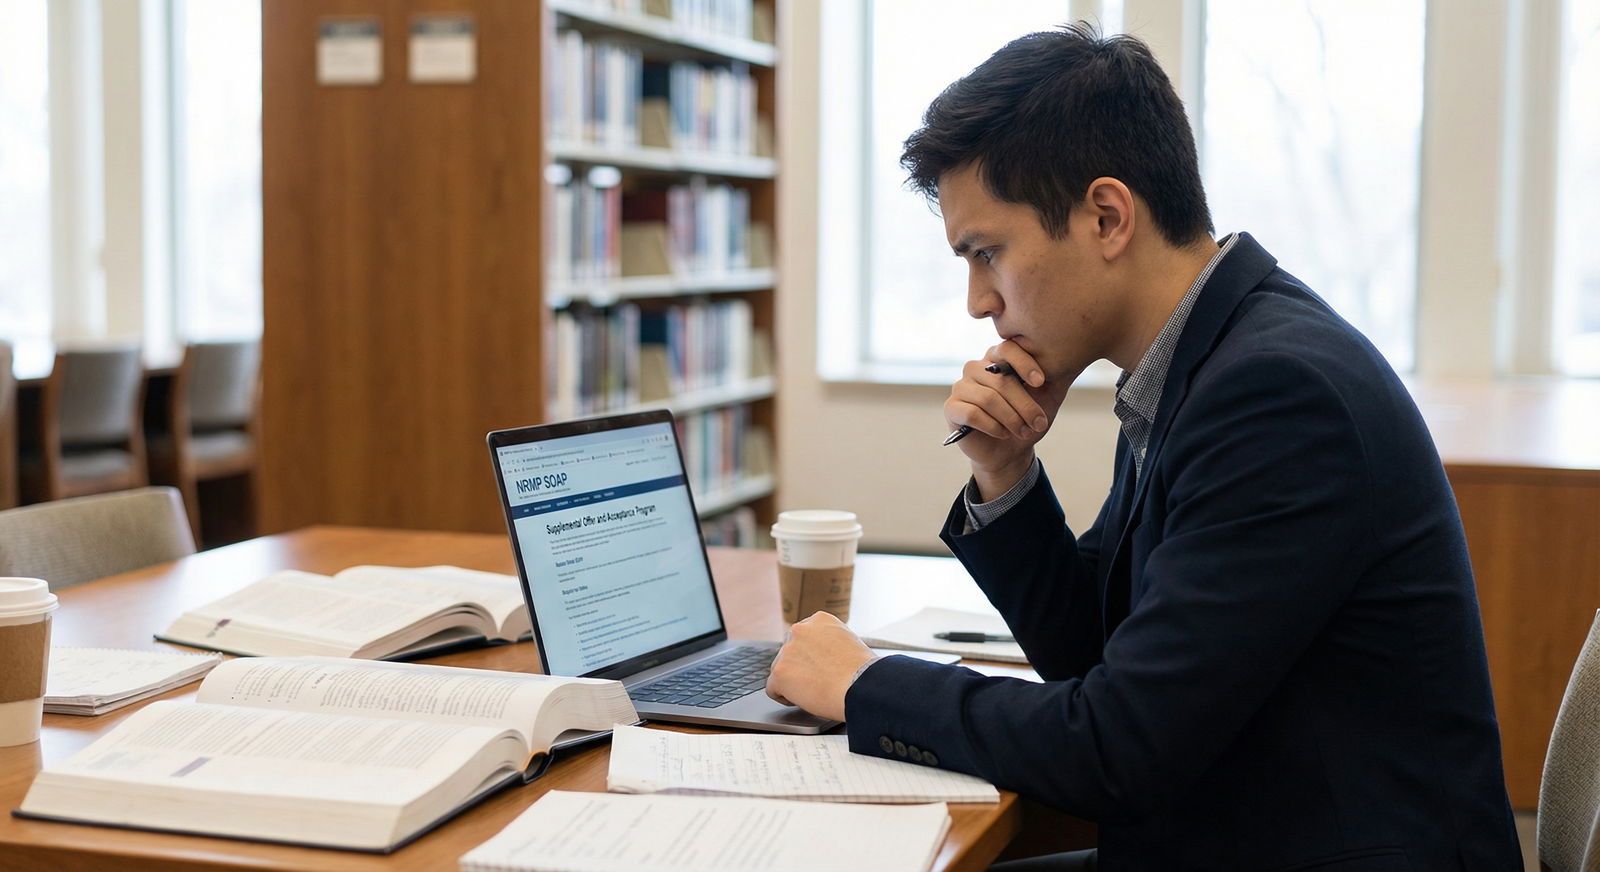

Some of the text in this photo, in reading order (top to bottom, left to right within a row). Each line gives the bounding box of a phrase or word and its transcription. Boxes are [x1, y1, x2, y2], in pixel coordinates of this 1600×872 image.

[516, 477, 542, 494] NRMP
[544, 472, 567, 489] SOAP
[546, 518, 582, 535] Supplemental
[597, 513, 606, 523] and
[607, 509, 635, 521] Acceptance
[635, 505, 655, 516] Program
